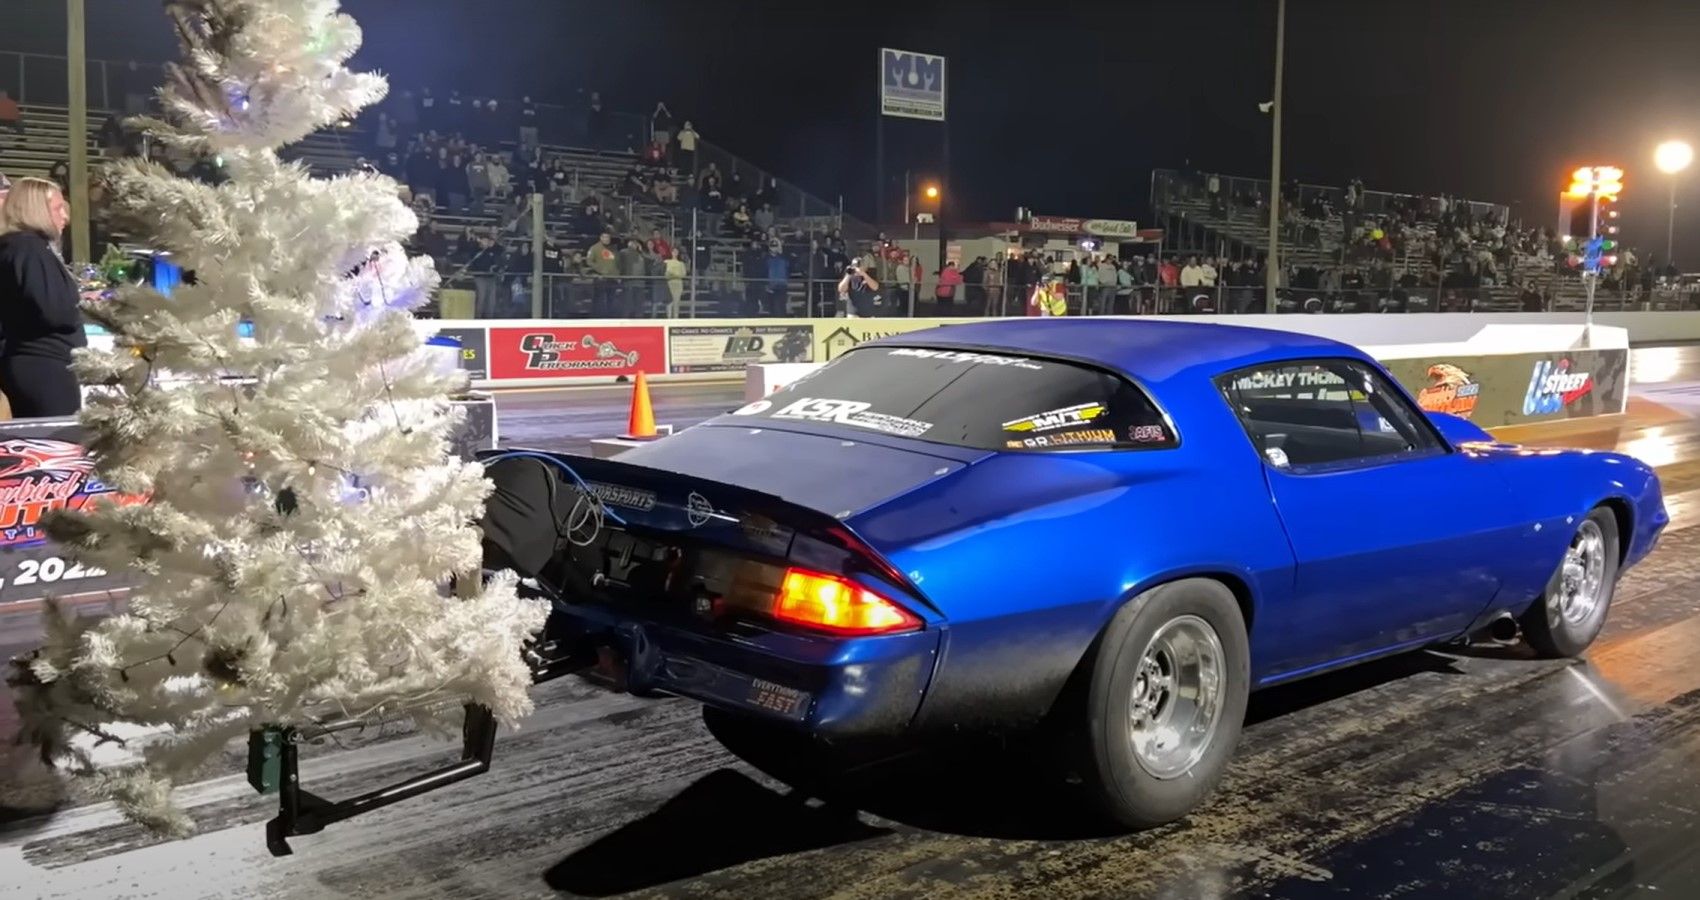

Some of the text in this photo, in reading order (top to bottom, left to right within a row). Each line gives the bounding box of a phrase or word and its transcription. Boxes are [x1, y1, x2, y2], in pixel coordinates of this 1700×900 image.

[1031, 216, 1079, 231] Budweiser
[520, 333, 577, 353] QUICK
[862, 331, 905, 341] BAN
[525, 350, 626, 370] PERFORMANCE
[1232, 373, 1295, 391] MICKEY
[1543, 372, 1589, 394] STREET
[771, 398, 872, 423] KSR
[13, 557, 107, 586] 202
